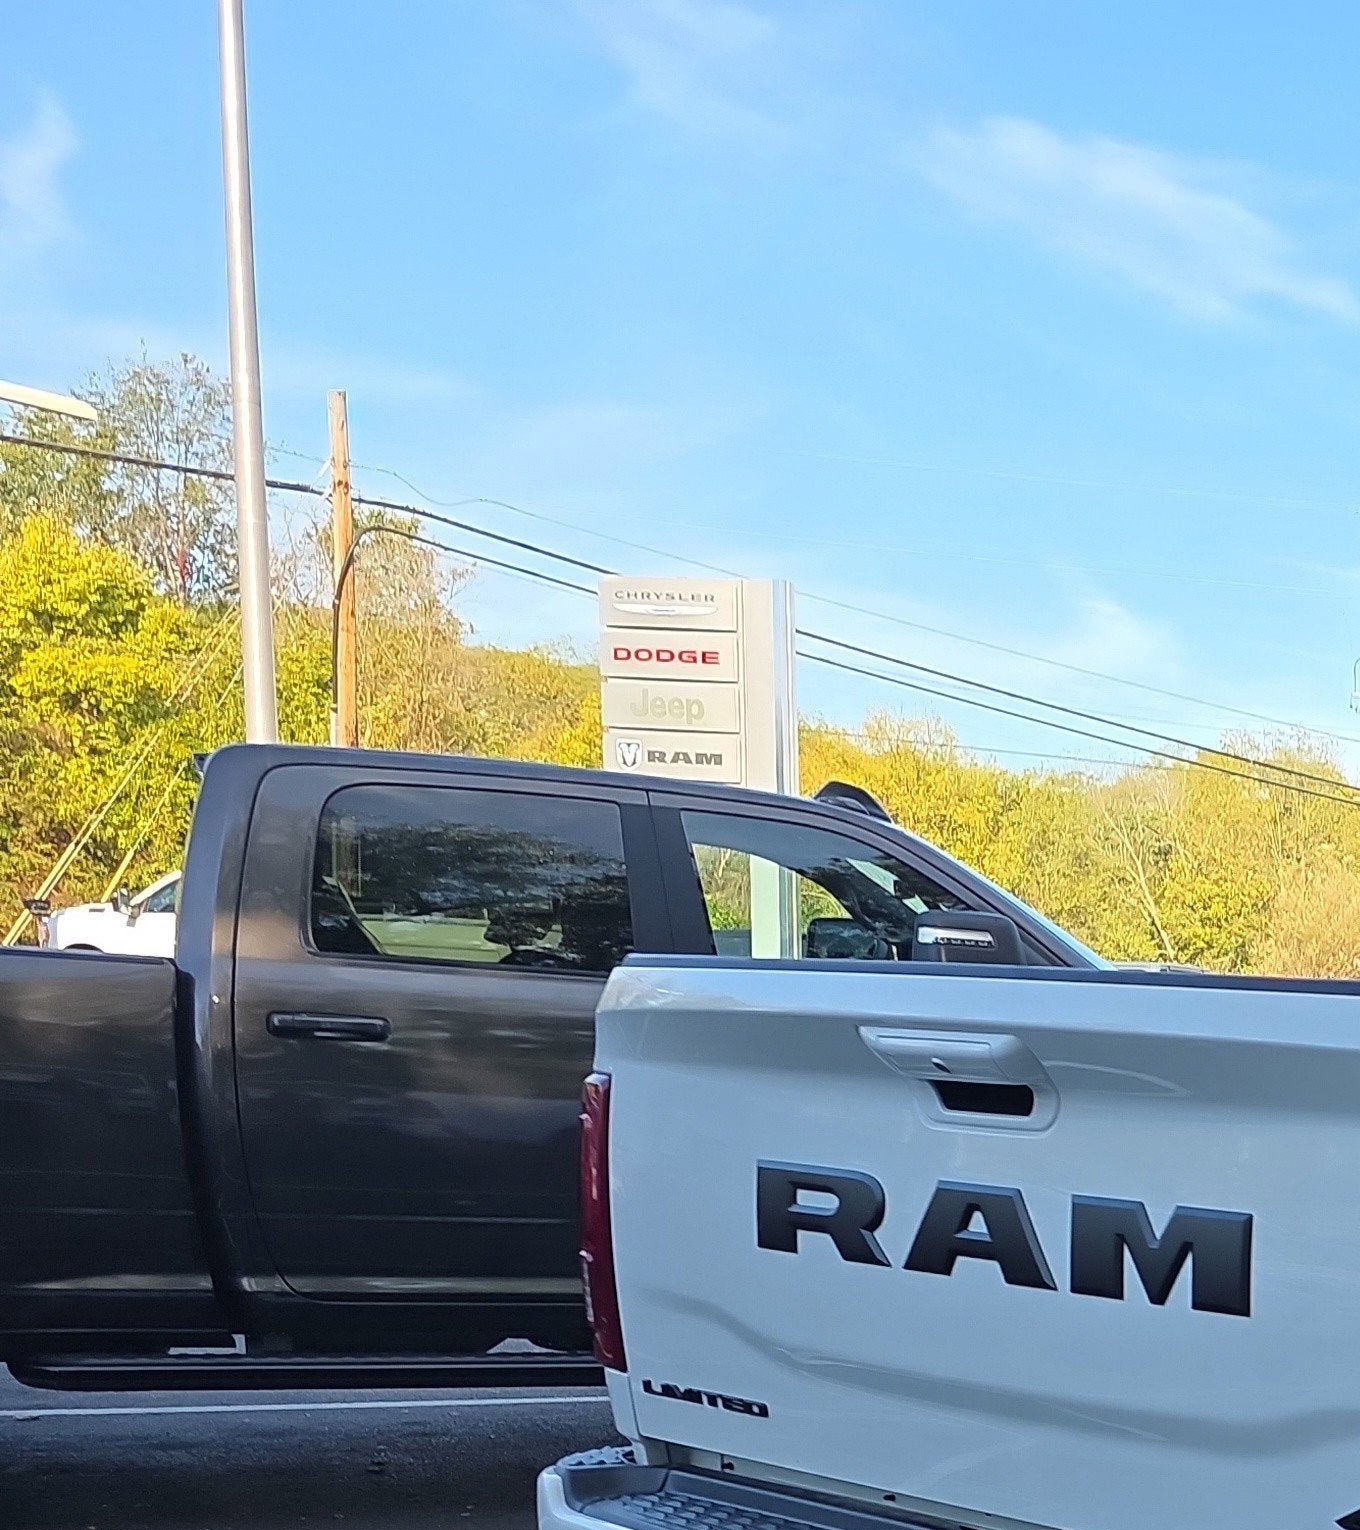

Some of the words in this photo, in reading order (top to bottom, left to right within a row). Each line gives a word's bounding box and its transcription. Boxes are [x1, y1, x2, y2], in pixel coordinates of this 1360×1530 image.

[614, 590, 716, 604] CHRYSLER
[613, 647, 721, 666] DODGE
[630, 689, 706, 724] Jeep
[647, 749, 723, 767] RAM
[757, 1159, 1255, 1317] RAM
[641, 1379, 770, 1419] LIMITED
